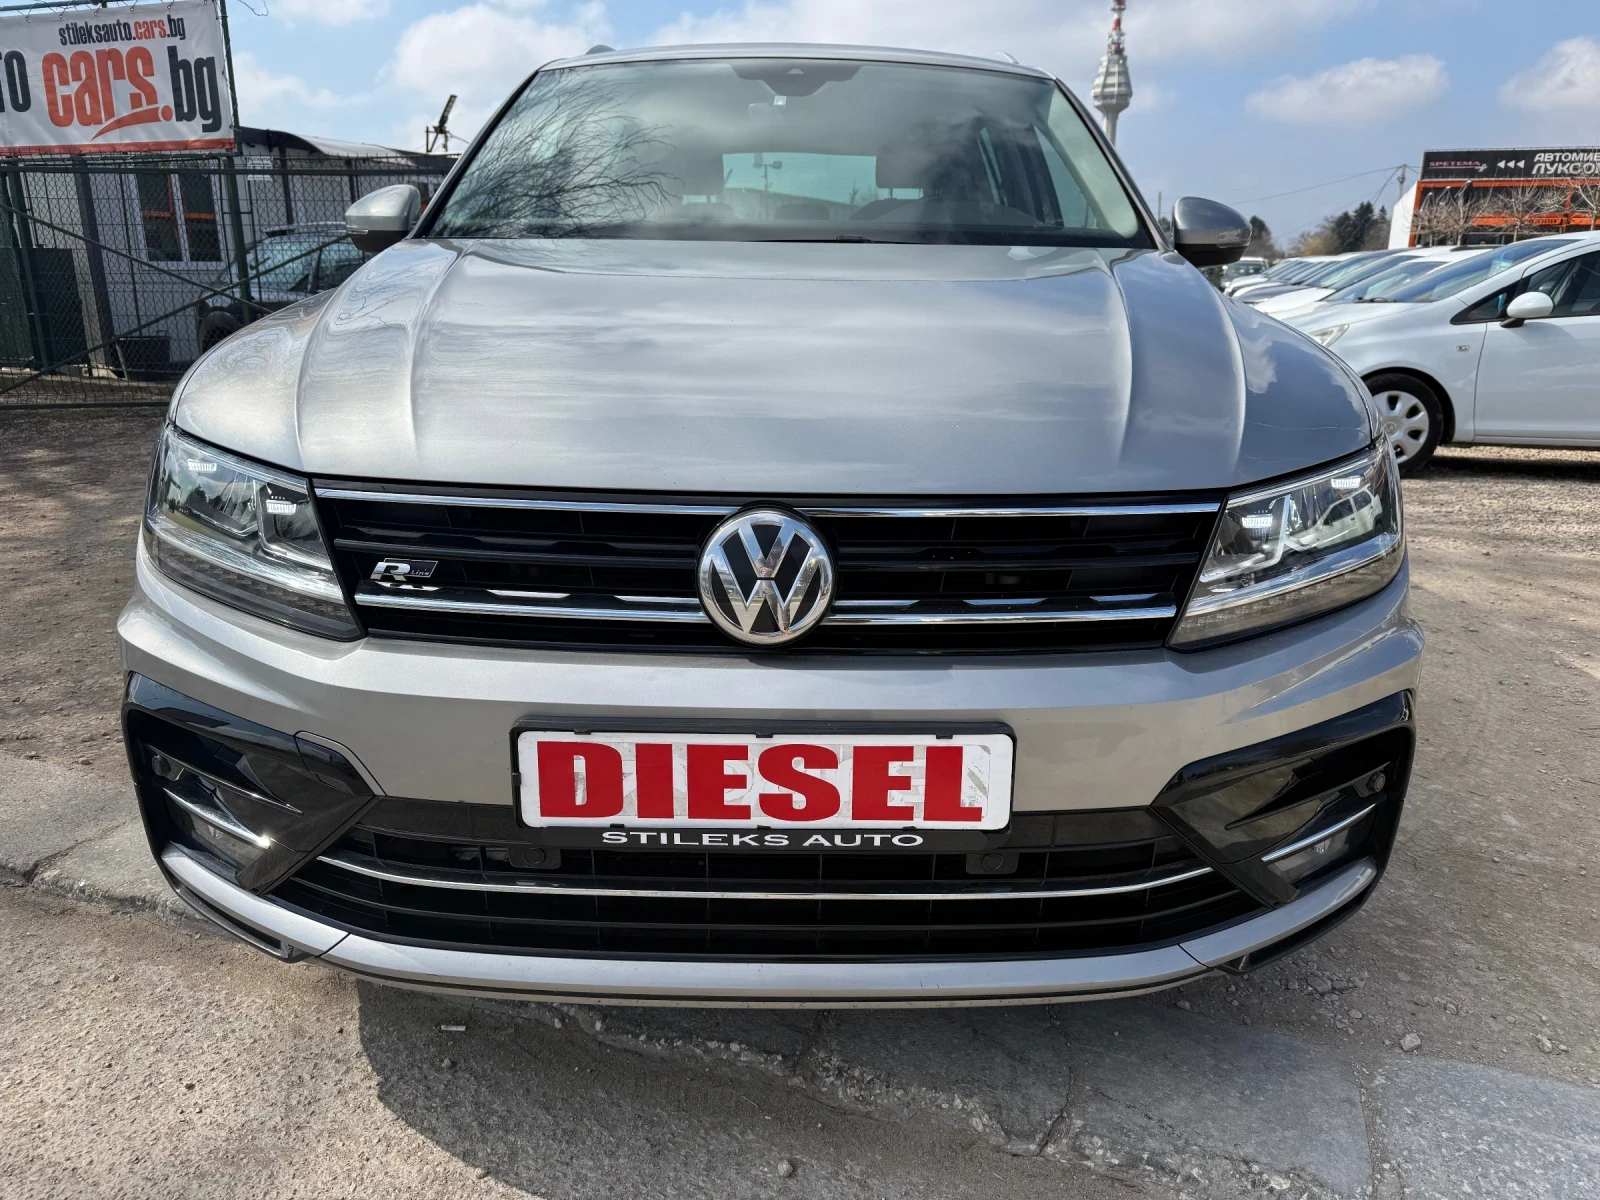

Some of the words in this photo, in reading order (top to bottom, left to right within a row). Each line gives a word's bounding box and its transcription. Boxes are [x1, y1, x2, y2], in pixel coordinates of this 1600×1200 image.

[58, 14, 187, 46] stileksauto.cars.bg
[41, 45, 222, 133] cars.bg
[370, 561, 411, 581] R
[537, 740, 983, 823] DIESEL
[602, 831, 790, 847] STILEKS
[802, 833, 923, 848] AUTO
